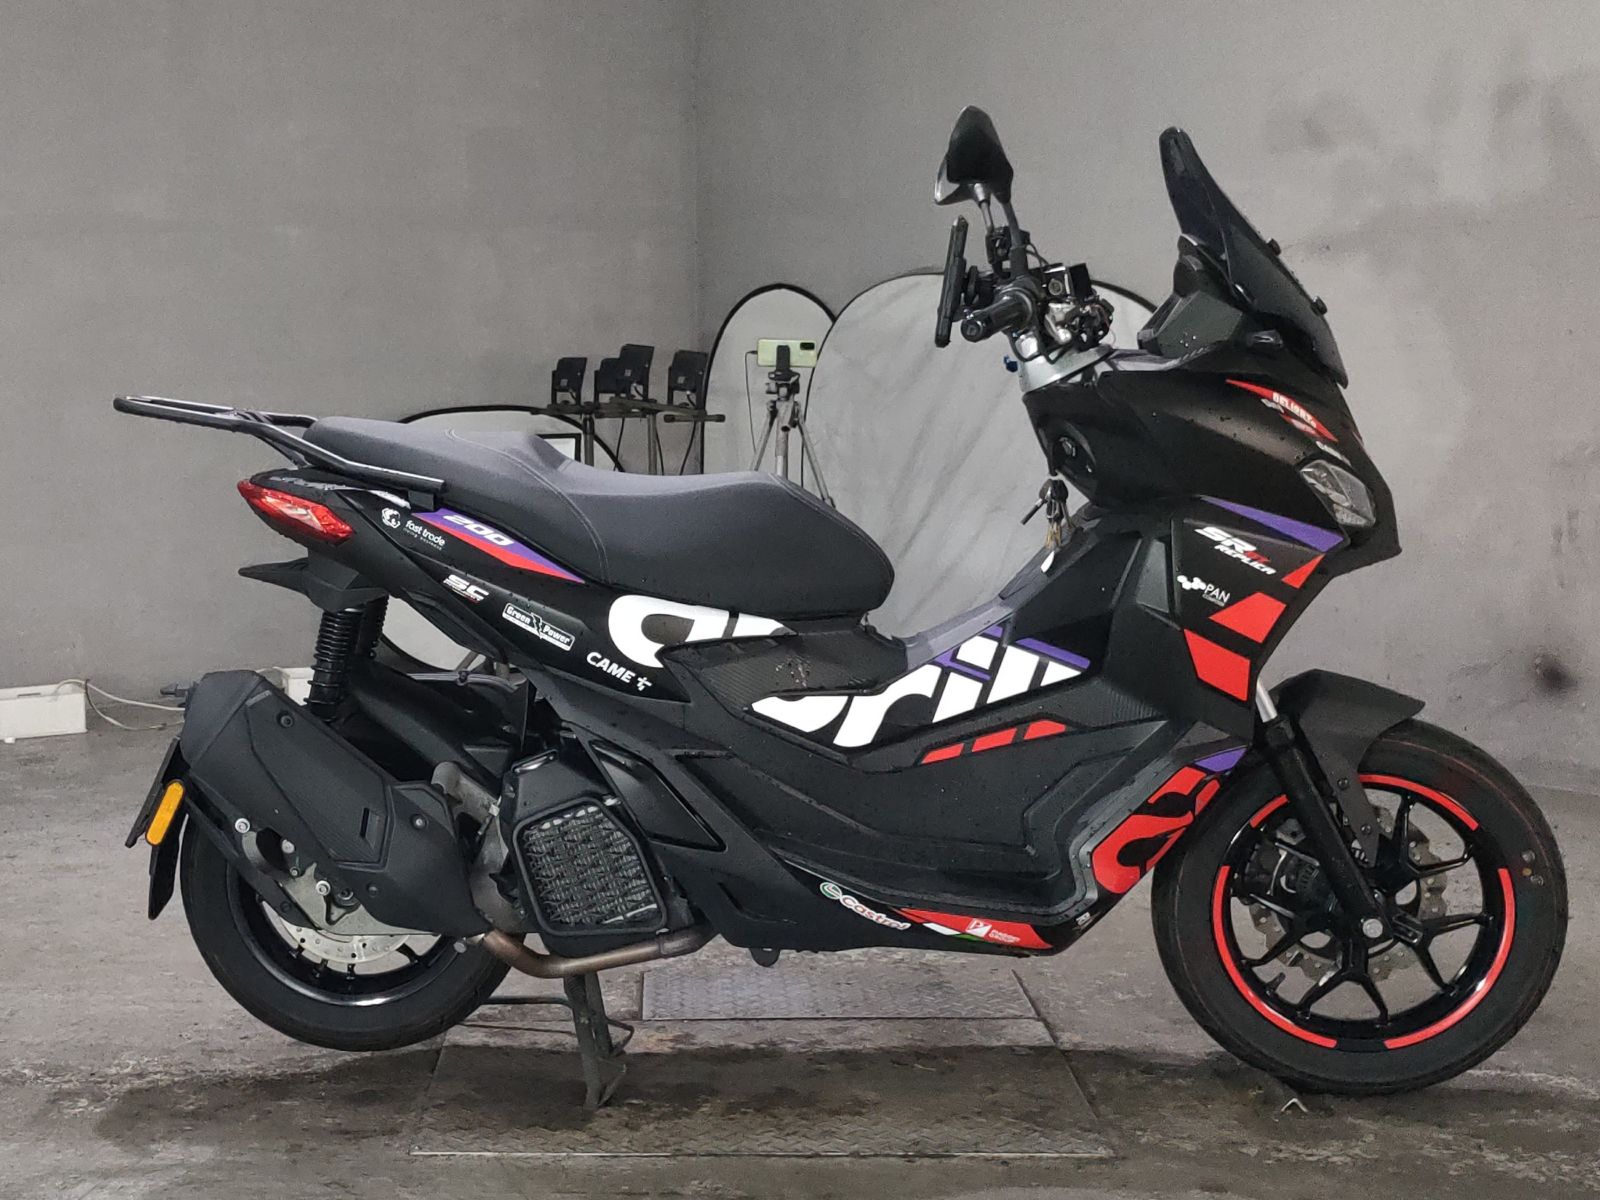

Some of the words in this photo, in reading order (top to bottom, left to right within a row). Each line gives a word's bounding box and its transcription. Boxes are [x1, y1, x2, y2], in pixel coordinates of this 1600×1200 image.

[405, 520, 423, 535] fast
[422, 528, 446, 547] trade
[442, 514, 515, 546] 200
[1213, 544, 1277, 575] REPLICA
[1203, 583, 1231, 603] PAN
[506, 605, 531, 625] Green
[542, 624, 571, 644] Power
[586, 651, 636, 684] CAME
[839, 894, 912, 931] Castrol
